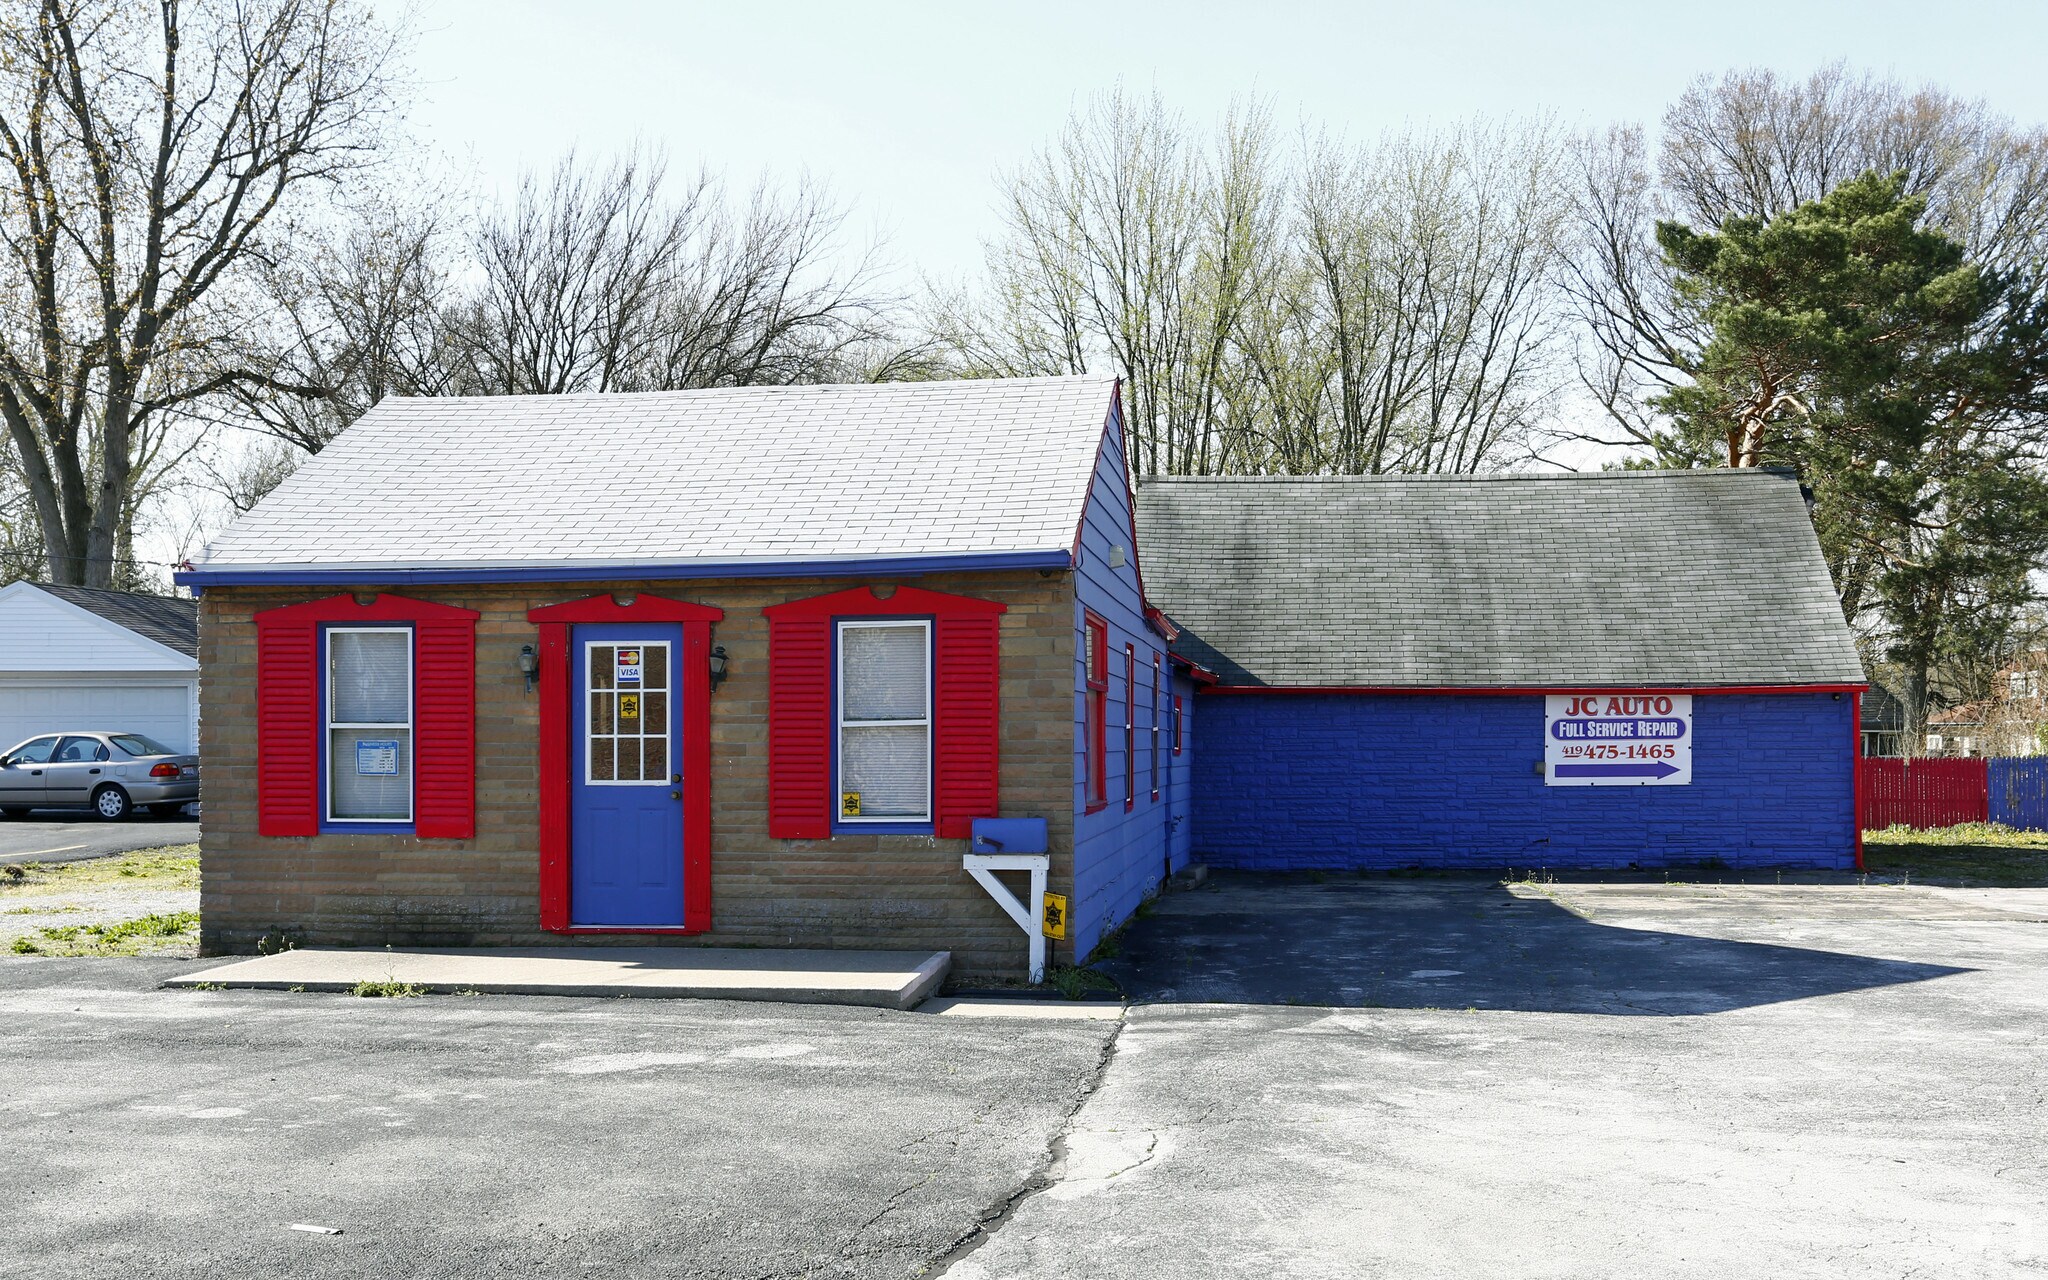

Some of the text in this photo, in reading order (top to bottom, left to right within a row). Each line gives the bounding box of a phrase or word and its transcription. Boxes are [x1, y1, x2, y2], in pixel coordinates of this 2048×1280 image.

[621, 668, 638, 676] VISA
[1565, 696, 1674, 716] JC AUTO
[1559, 720, 1678, 737] FULL SERVICE REPAIR
[1562, 744, 1676, 759] 419 475-1465
